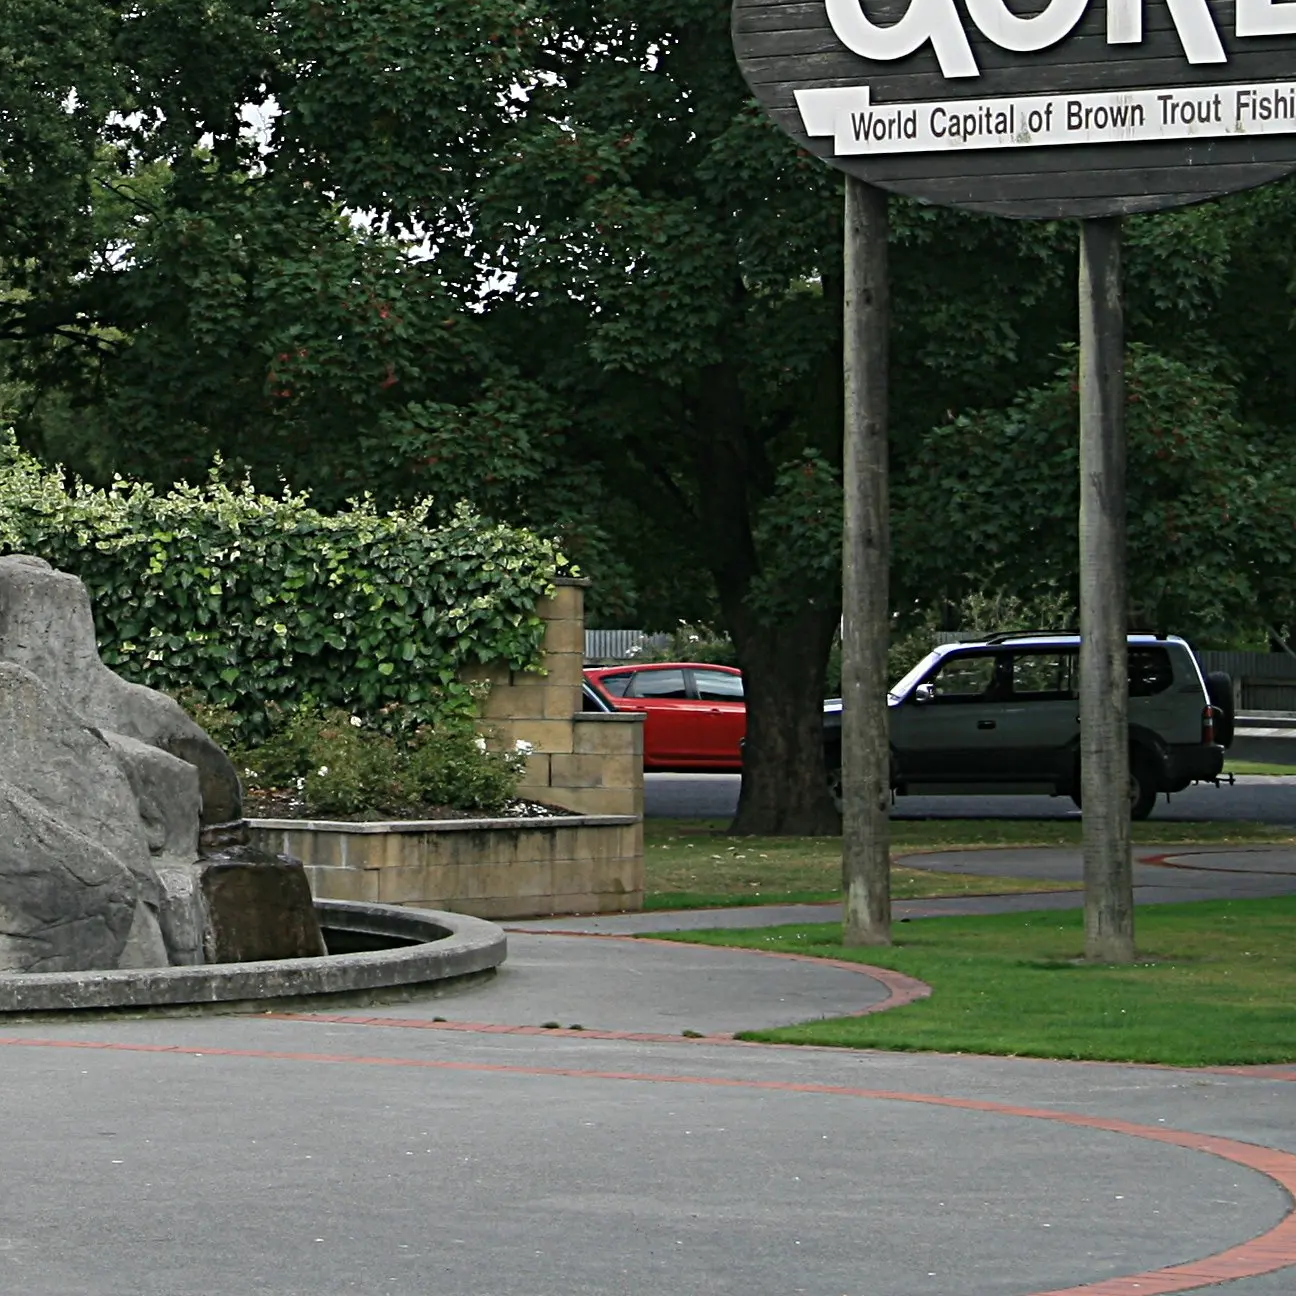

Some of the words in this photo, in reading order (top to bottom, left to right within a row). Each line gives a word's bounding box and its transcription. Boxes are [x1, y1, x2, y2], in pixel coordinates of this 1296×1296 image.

[851, 109, 917, 141] World
[930, 104, 1015, 143] Capital
[1028, 102, 1053, 133] of
[1067, 100, 1144, 131] Brown
[1157, 93, 1222, 125] Trout
